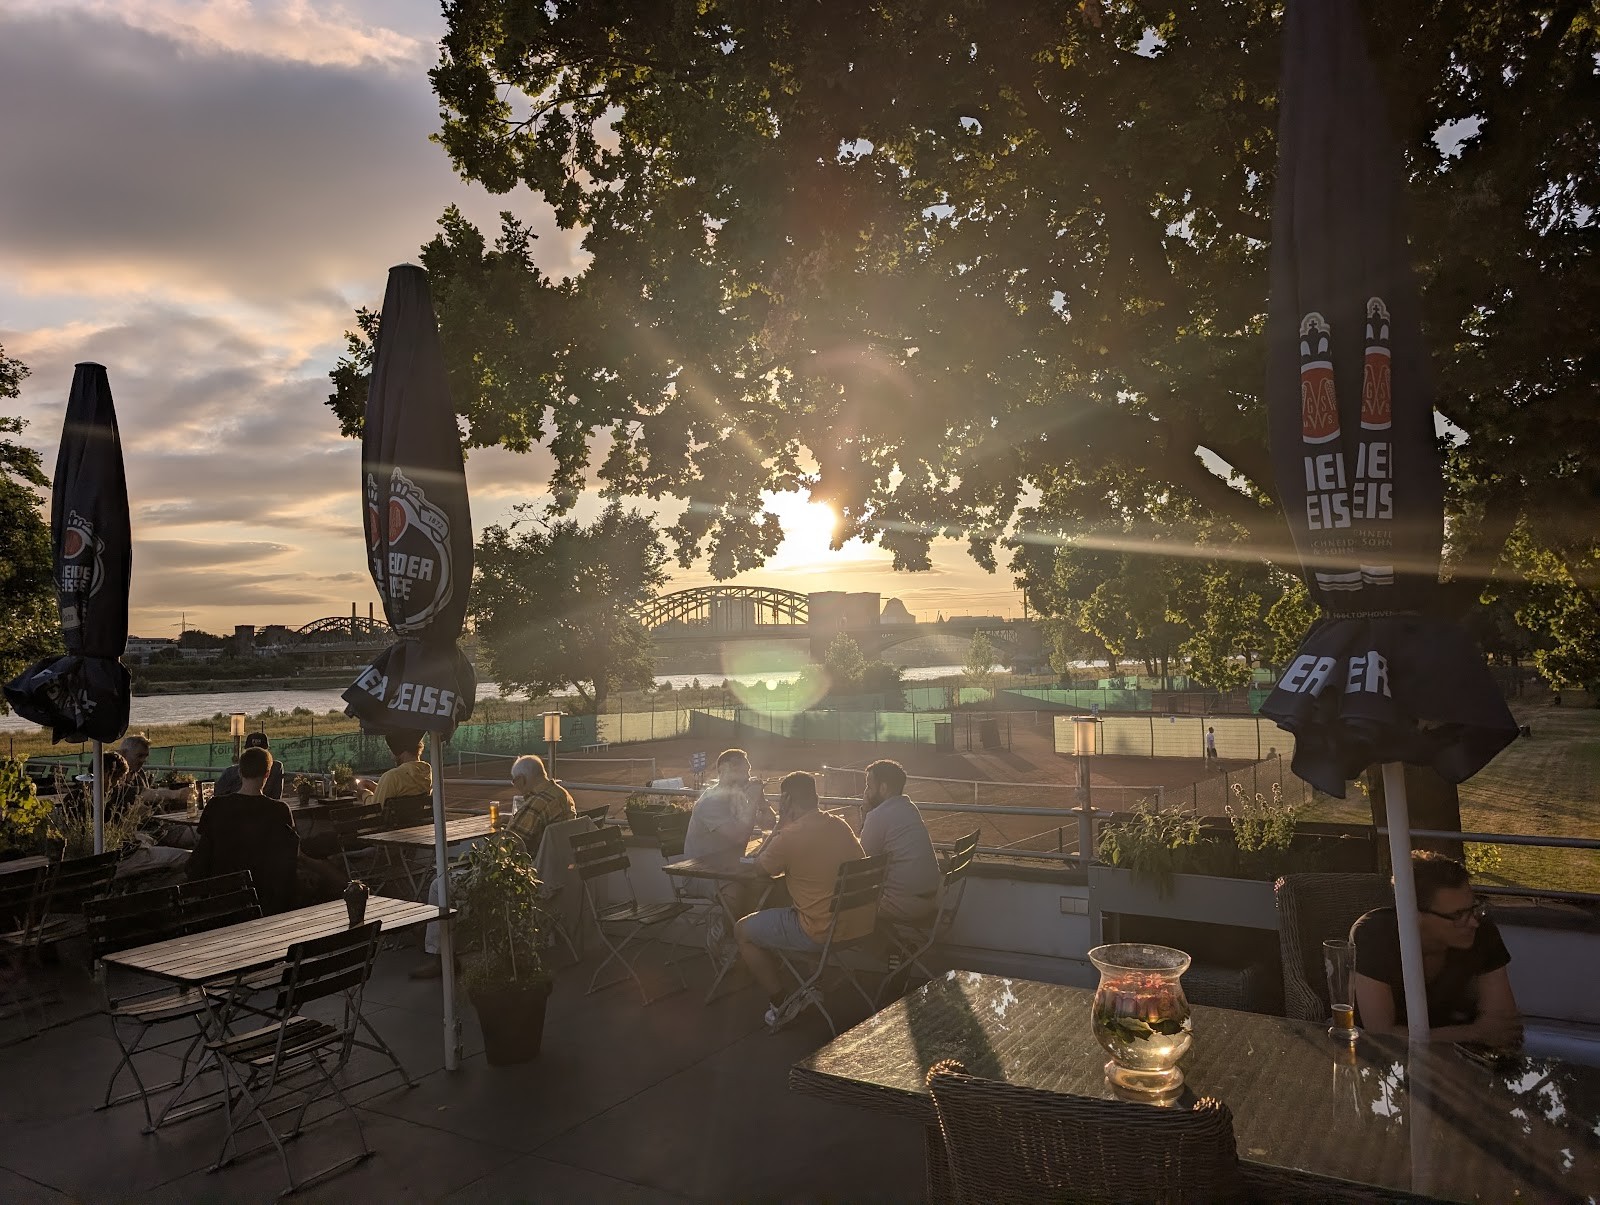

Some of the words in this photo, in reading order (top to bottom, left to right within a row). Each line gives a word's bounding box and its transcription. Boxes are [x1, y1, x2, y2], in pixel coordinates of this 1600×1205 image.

[428, 516, 443, 529] 1872
[1278, 655, 1337, 699] ER
[1345, 650, 1393, 699] ER
